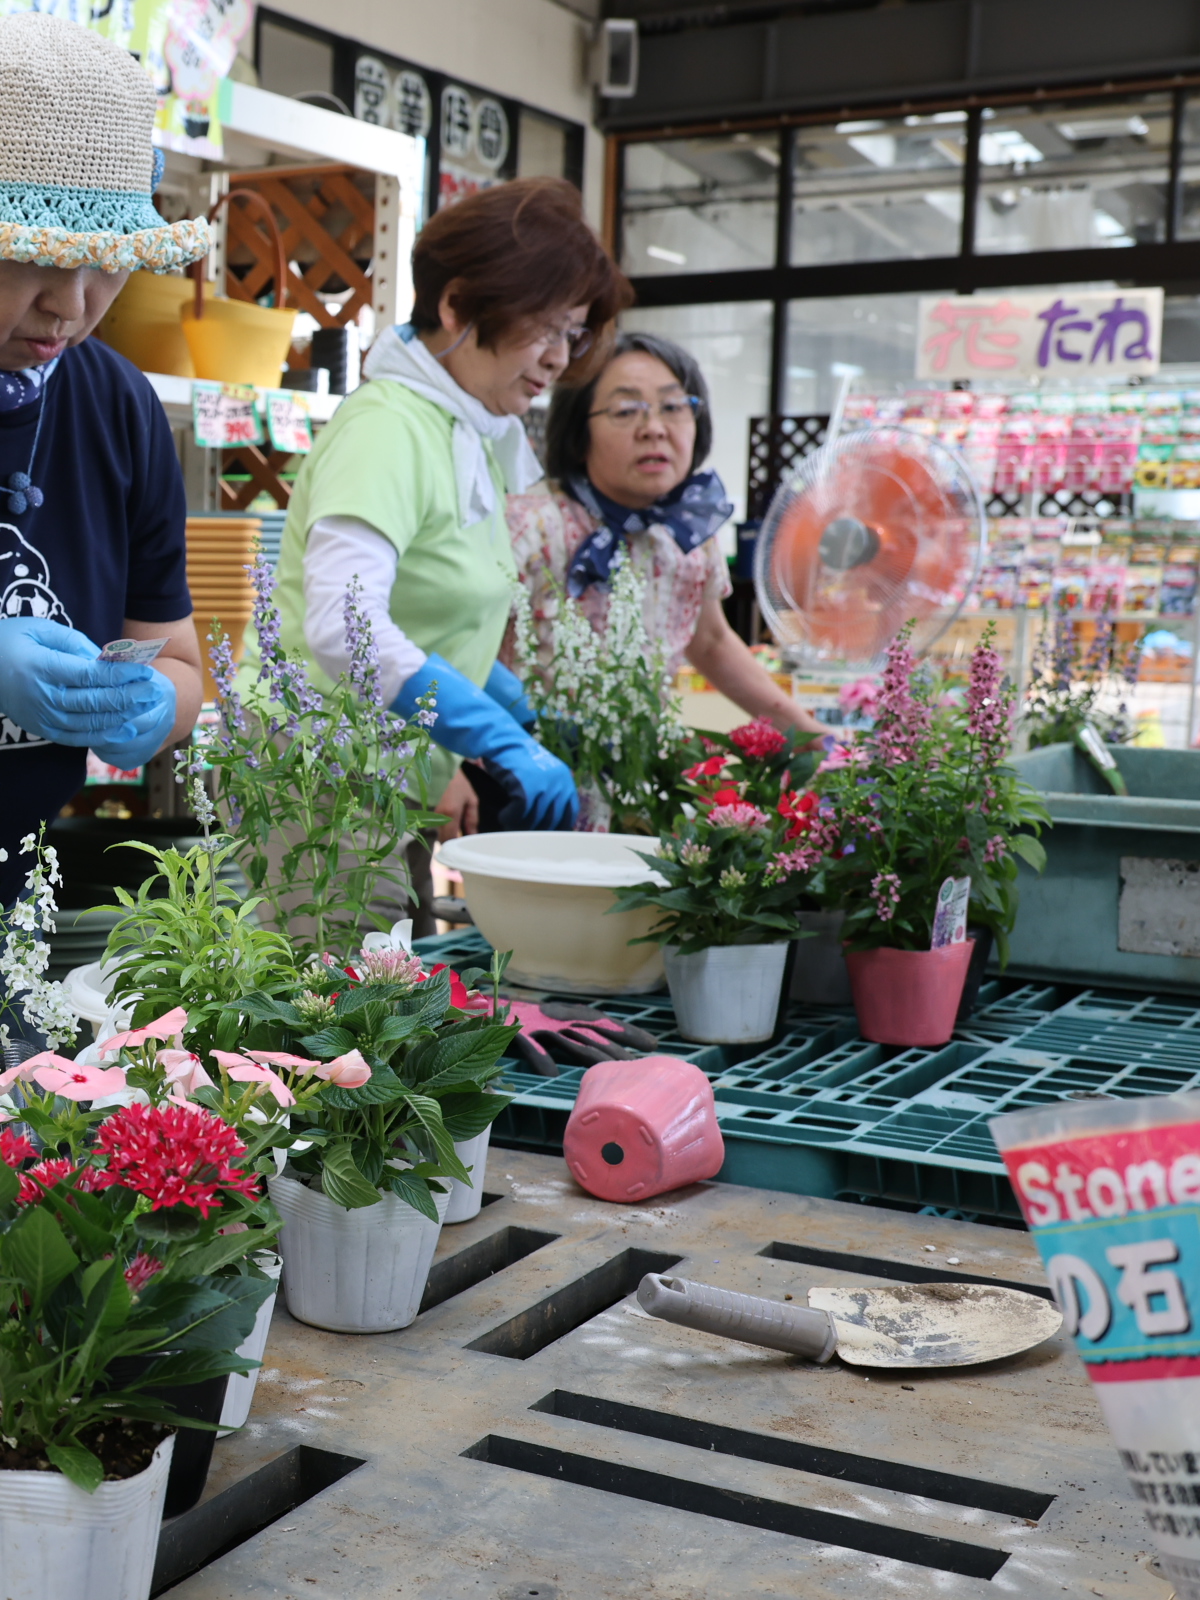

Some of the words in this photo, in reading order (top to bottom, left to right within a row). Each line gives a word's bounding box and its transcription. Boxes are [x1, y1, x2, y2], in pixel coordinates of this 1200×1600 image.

[923, 298, 1154, 371] 花たね
[1017, 1154, 1200, 1227] Stone
